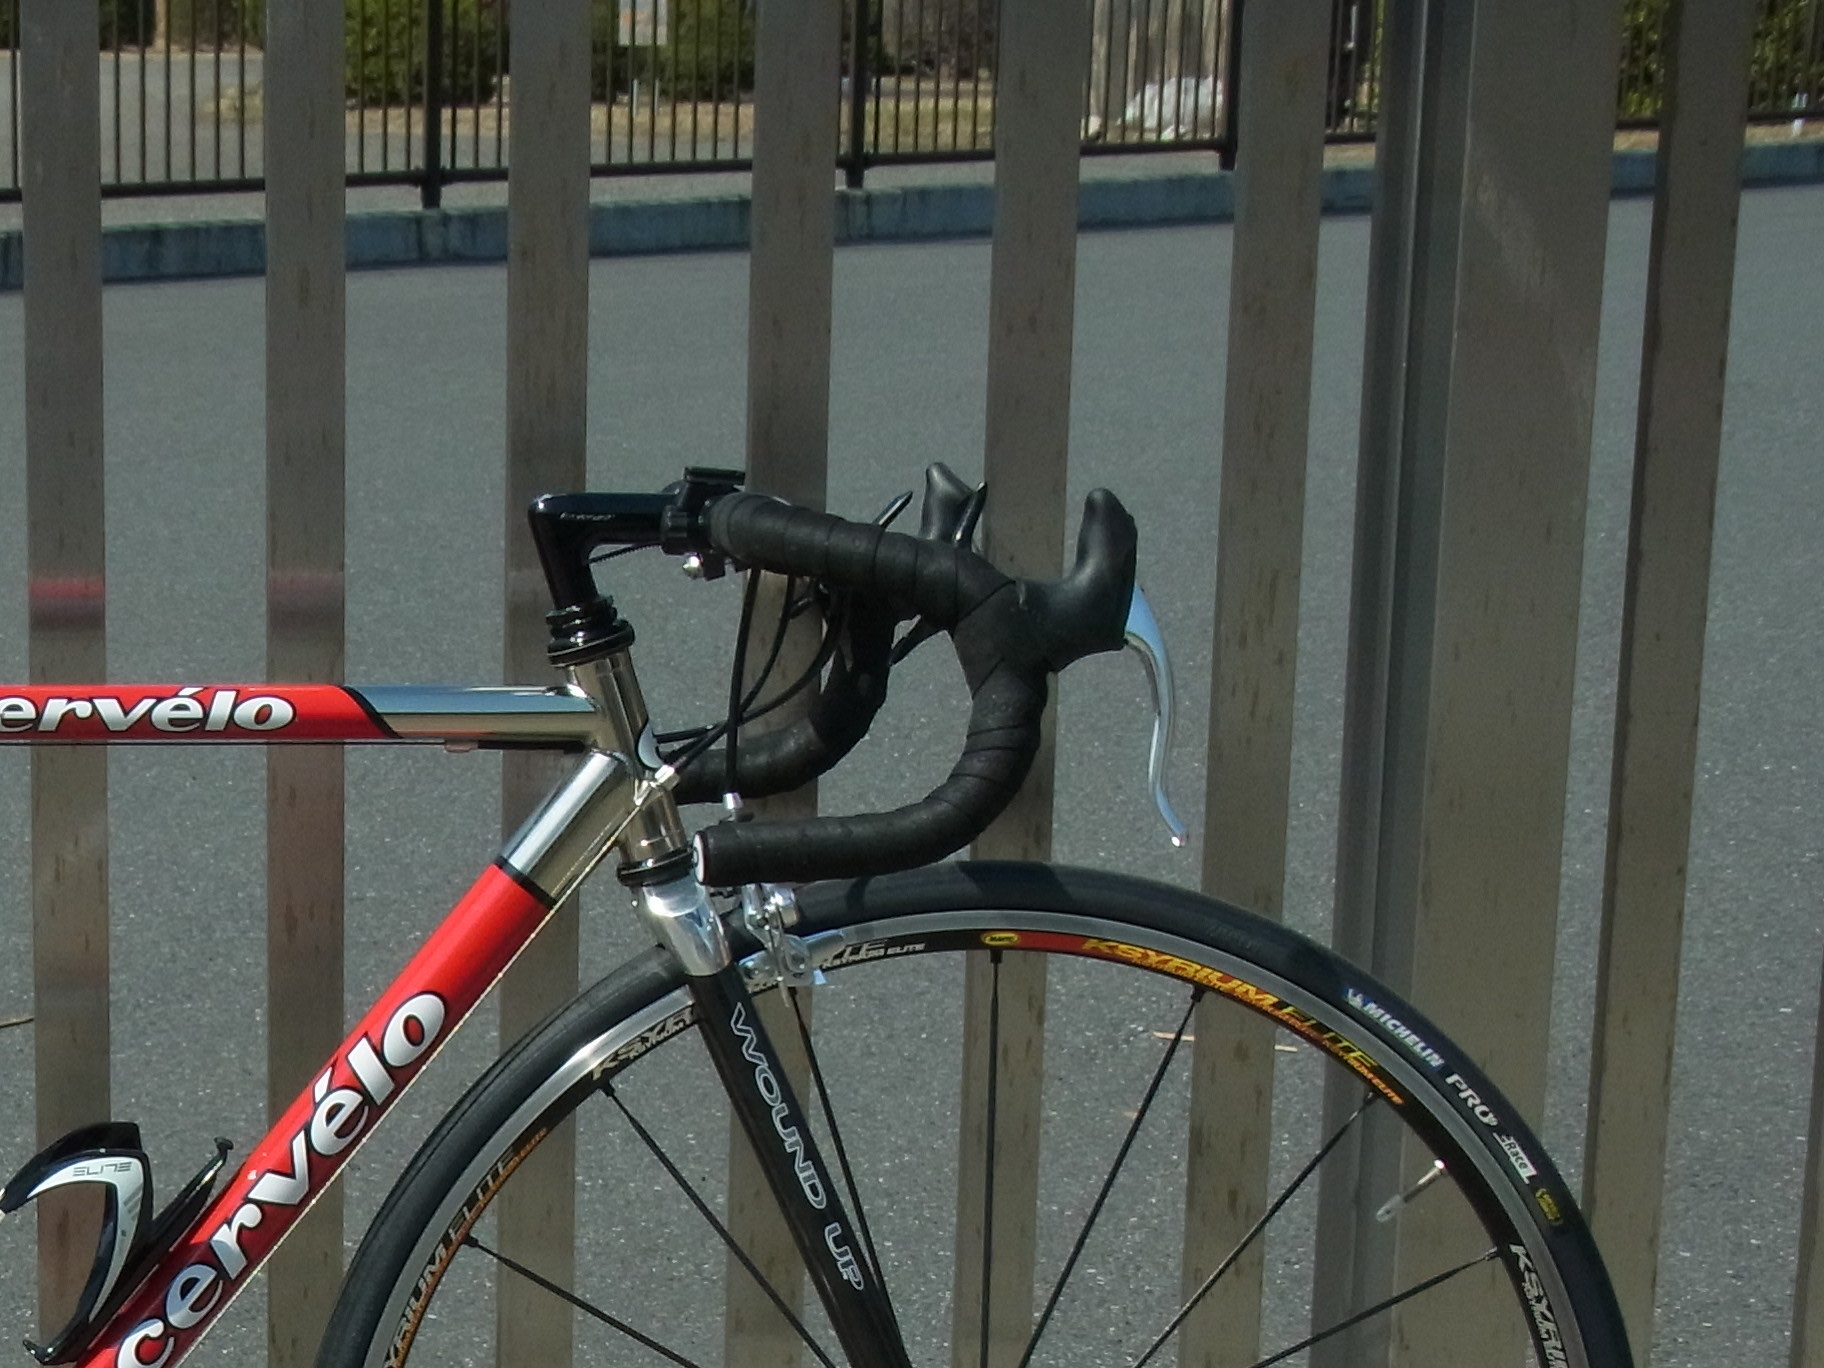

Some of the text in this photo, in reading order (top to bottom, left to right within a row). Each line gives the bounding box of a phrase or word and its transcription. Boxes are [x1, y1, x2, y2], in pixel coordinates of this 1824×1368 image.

[1361, 998, 1446, 1070] MICHELIN
[72, 1161, 132, 1177] ELITE
[729, 1002, 864, 1291] WOUND UP
